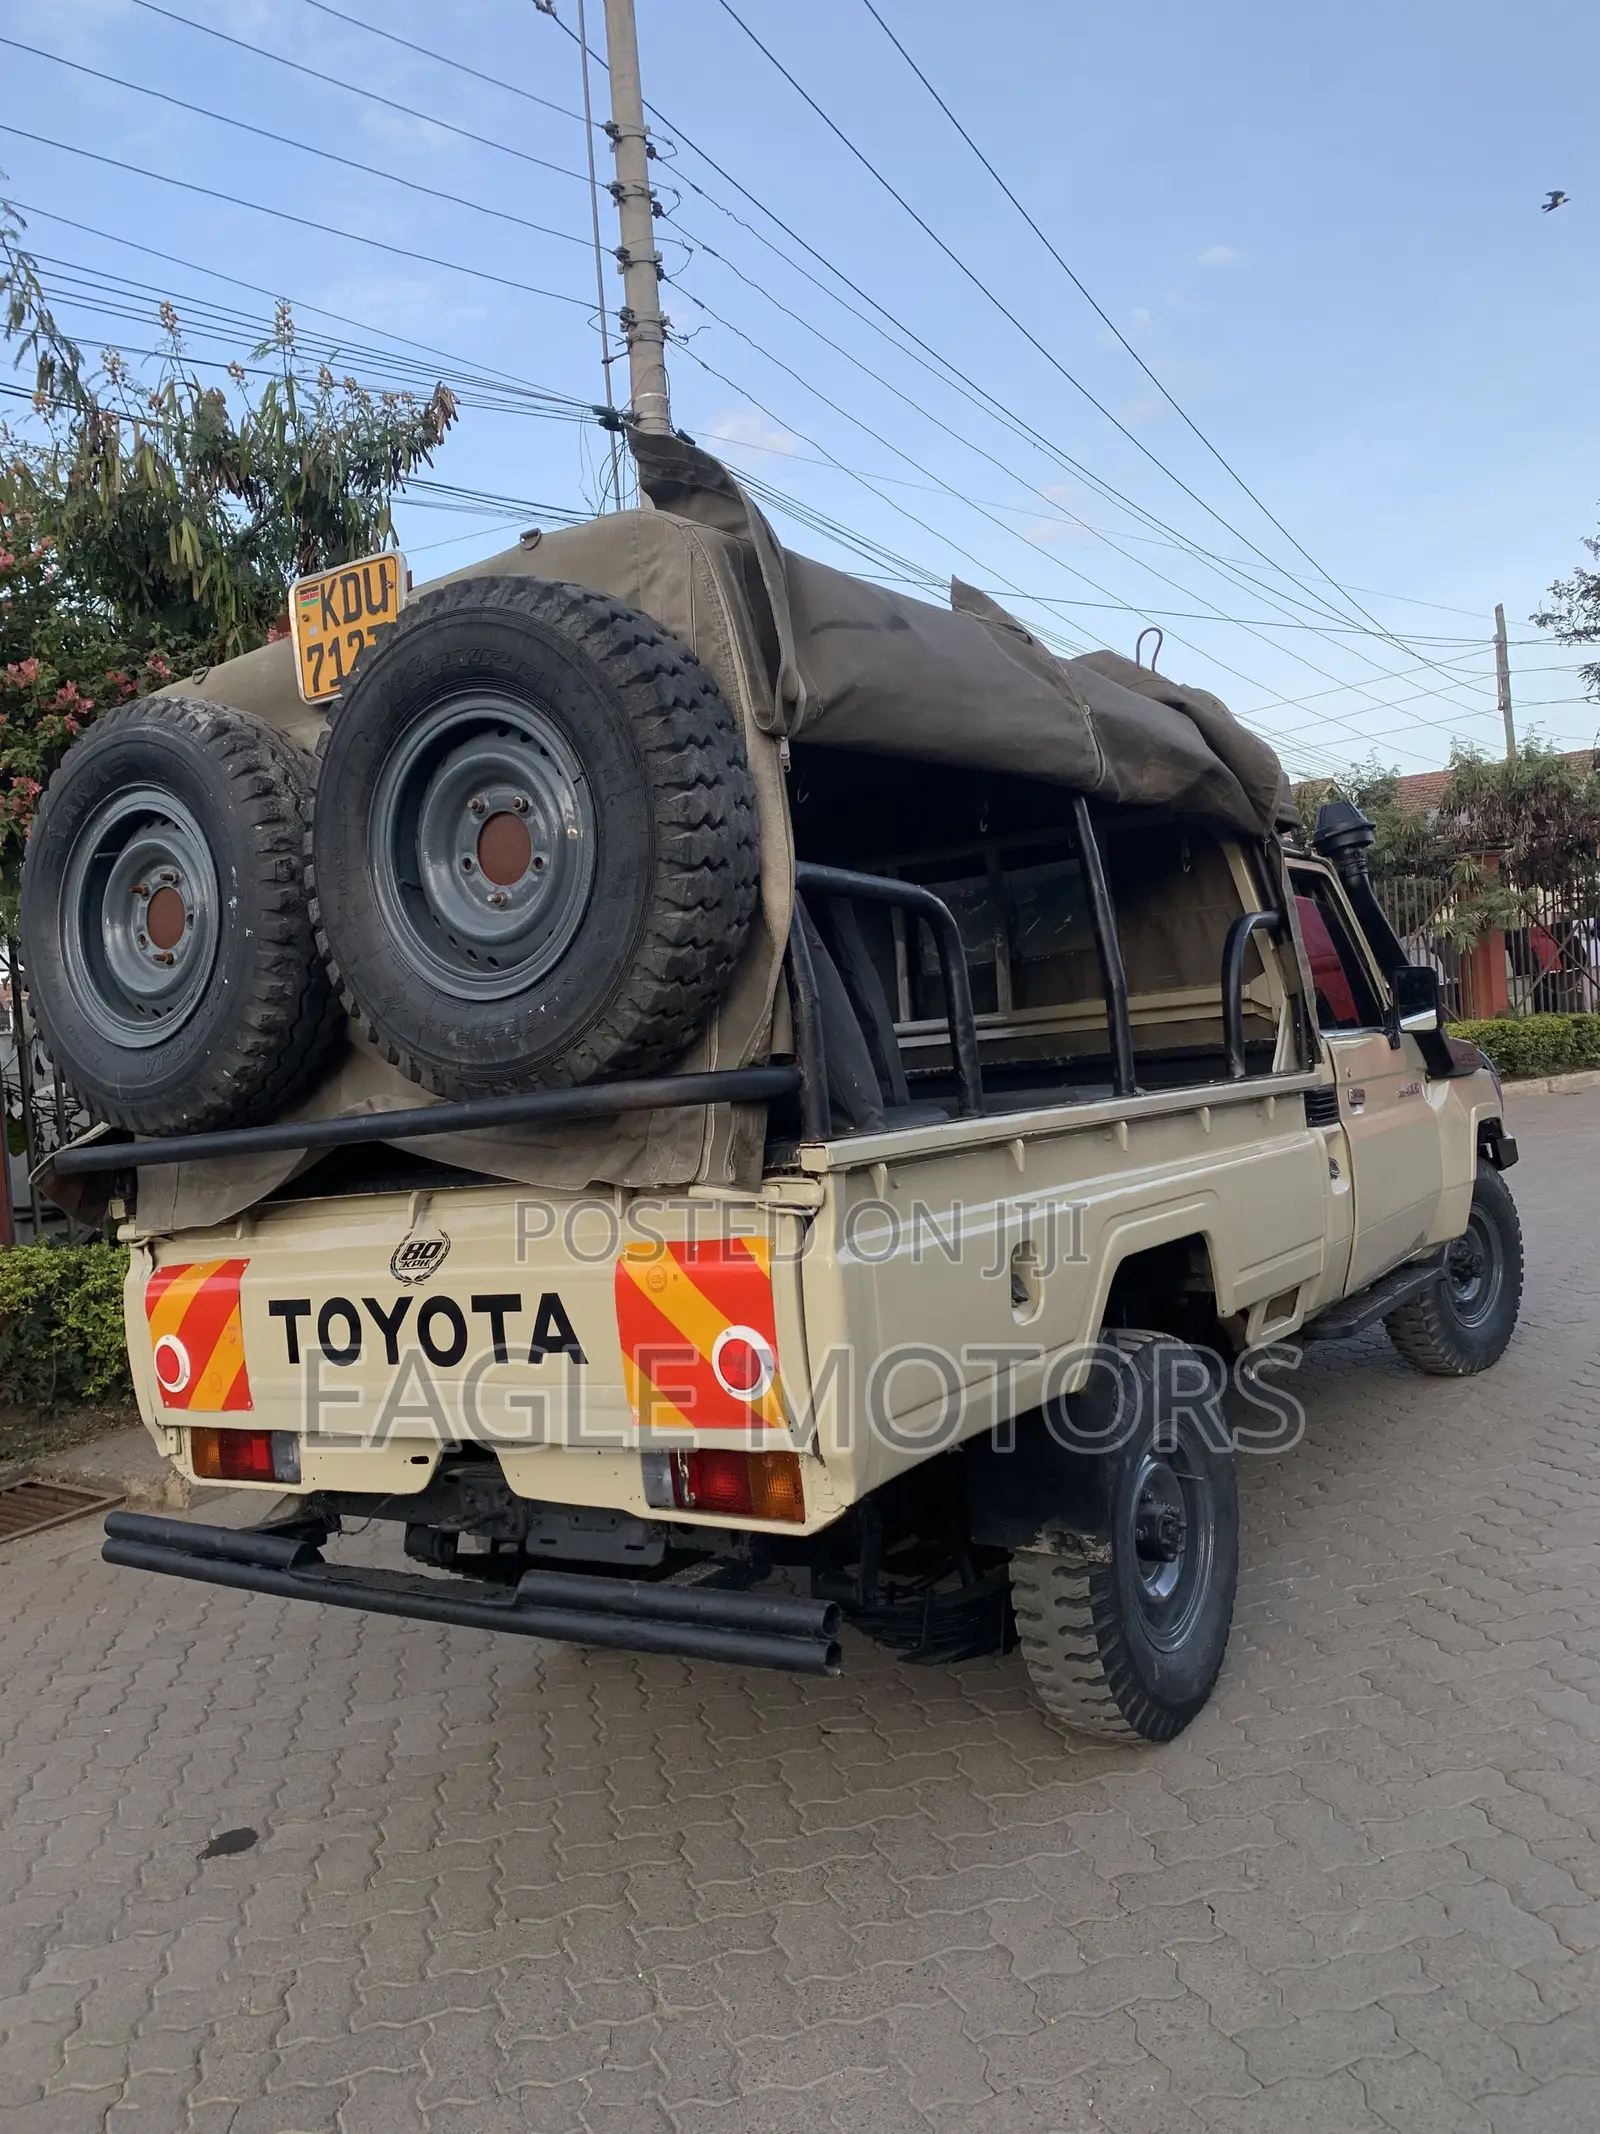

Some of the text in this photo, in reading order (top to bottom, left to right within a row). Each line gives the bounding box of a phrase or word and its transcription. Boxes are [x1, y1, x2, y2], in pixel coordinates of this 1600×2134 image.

[320, 562, 389, 631] KDU
[401, 1242, 443, 1260] 80
[402, 1259, 430, 1268] KPH
[269, 1292, 588, 1368] TOYOTA
